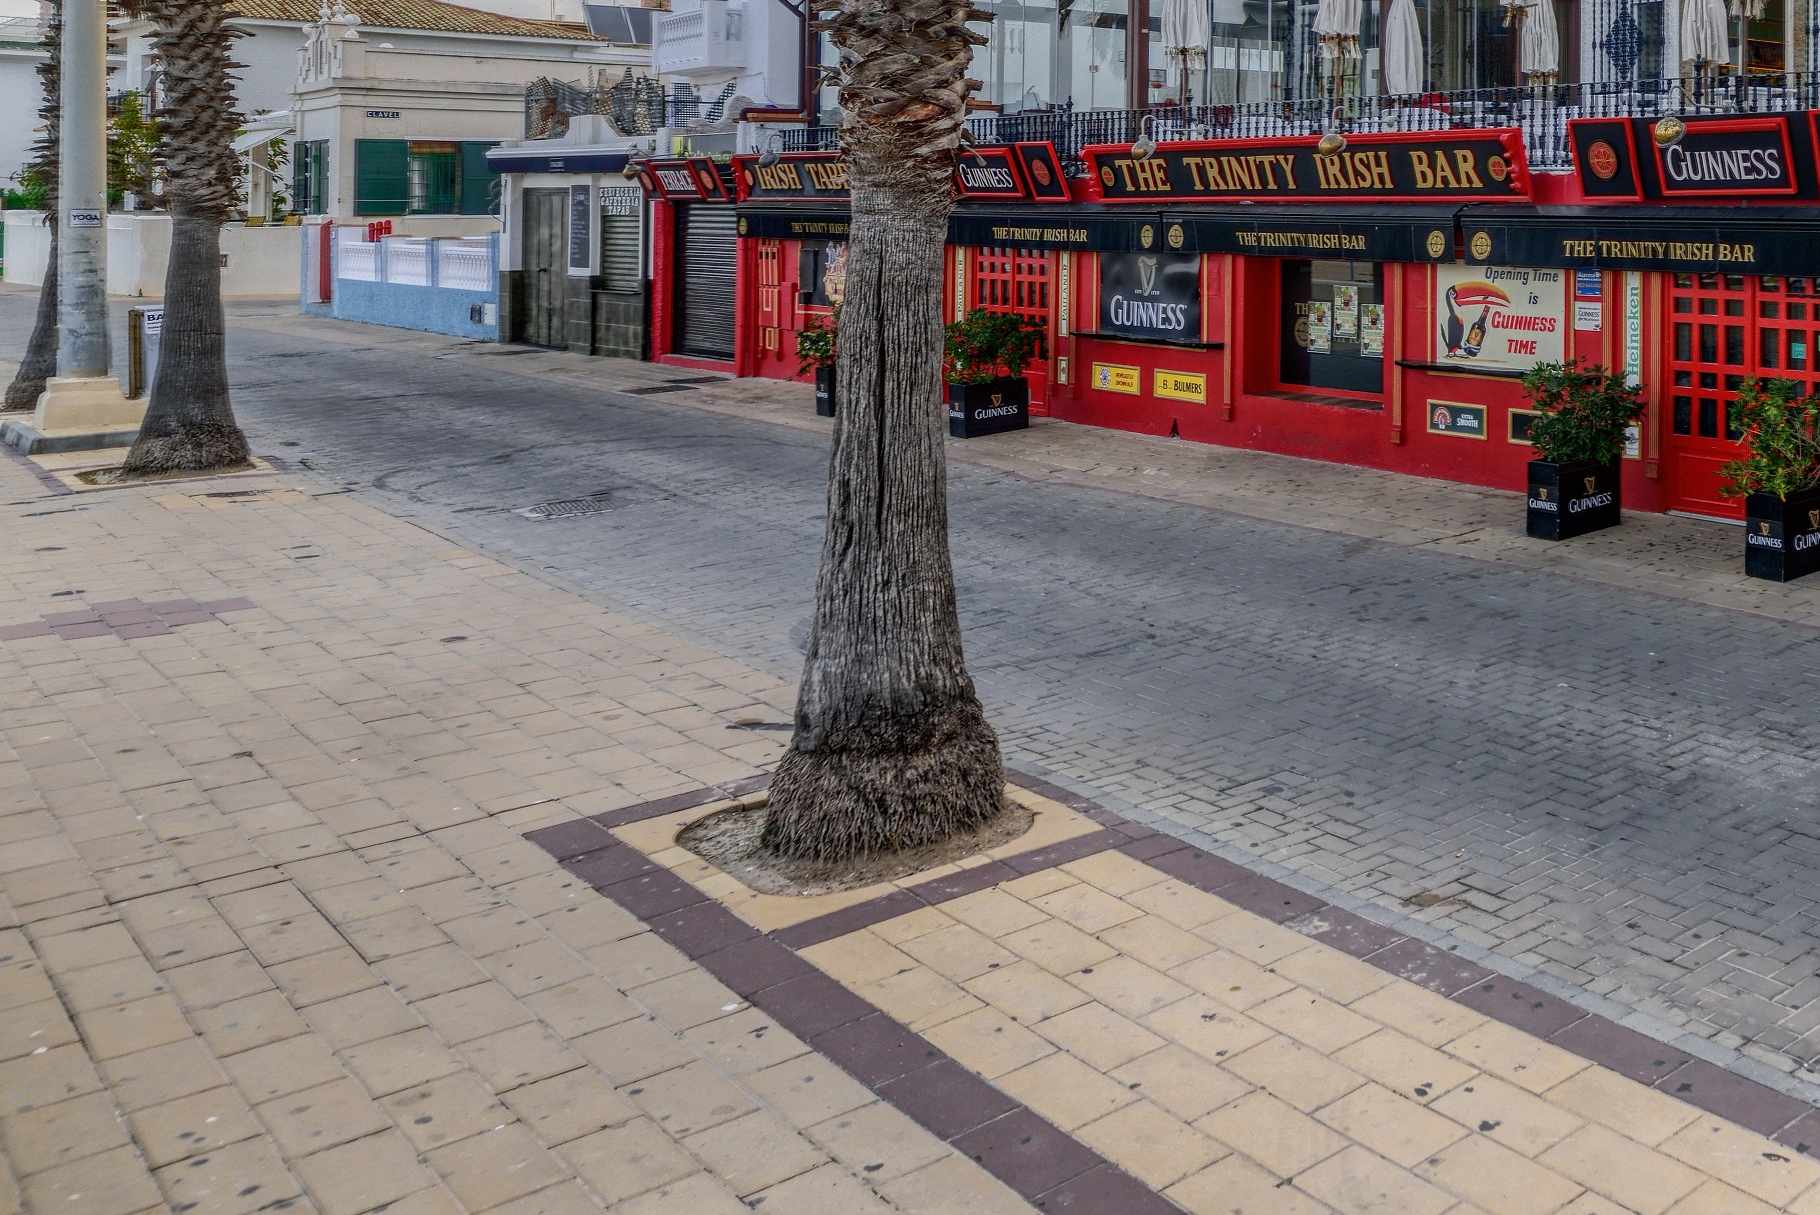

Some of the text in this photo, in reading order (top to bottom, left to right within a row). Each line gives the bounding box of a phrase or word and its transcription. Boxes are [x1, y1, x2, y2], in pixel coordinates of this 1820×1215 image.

[1114, 149, 1483, 191] THE TRINITY IRISH BAR
[1666, 145, 1781, 182] GUINNESS
[655, 170, 697, 191] TERRACE
[754, 163, 803, 190] IRISH
[959, 163, 1013, 188] GUINNESS
[600, 197, 639, 206] CAFETERIA
[608, 206, 630, 215] TAPAS
[992, 227, 1088, 242] THE TRINITY IRISH BAR
[1236, 231, 1366, 250] THE TRINITY IRISH BAR
[1563, 240, 1755, 263] THE TRINITY IRISH BAR
[1484, 266, 1559, 285] Opening Time
[1528, 292, 1539, 305] is
[1110, 295, 1184, 331] GUINNESS
[1490, 310, 1557, 333] GUINNESS
[1627, 286, 1640, 377] Heineken
[1507, 339, 1537, 355] TIME
[1173, 379, 1203, 394] BULMERS
[974, 404, 1019, 420] GUINNESS
[1456, 417, 1478, 428] SMOOTH
[1529, 498, 1558, 512] GUINNESS
[1568, 492, 1613, 513] GUINNESS
[1748, 533, 1782, 549] GUINNESS
